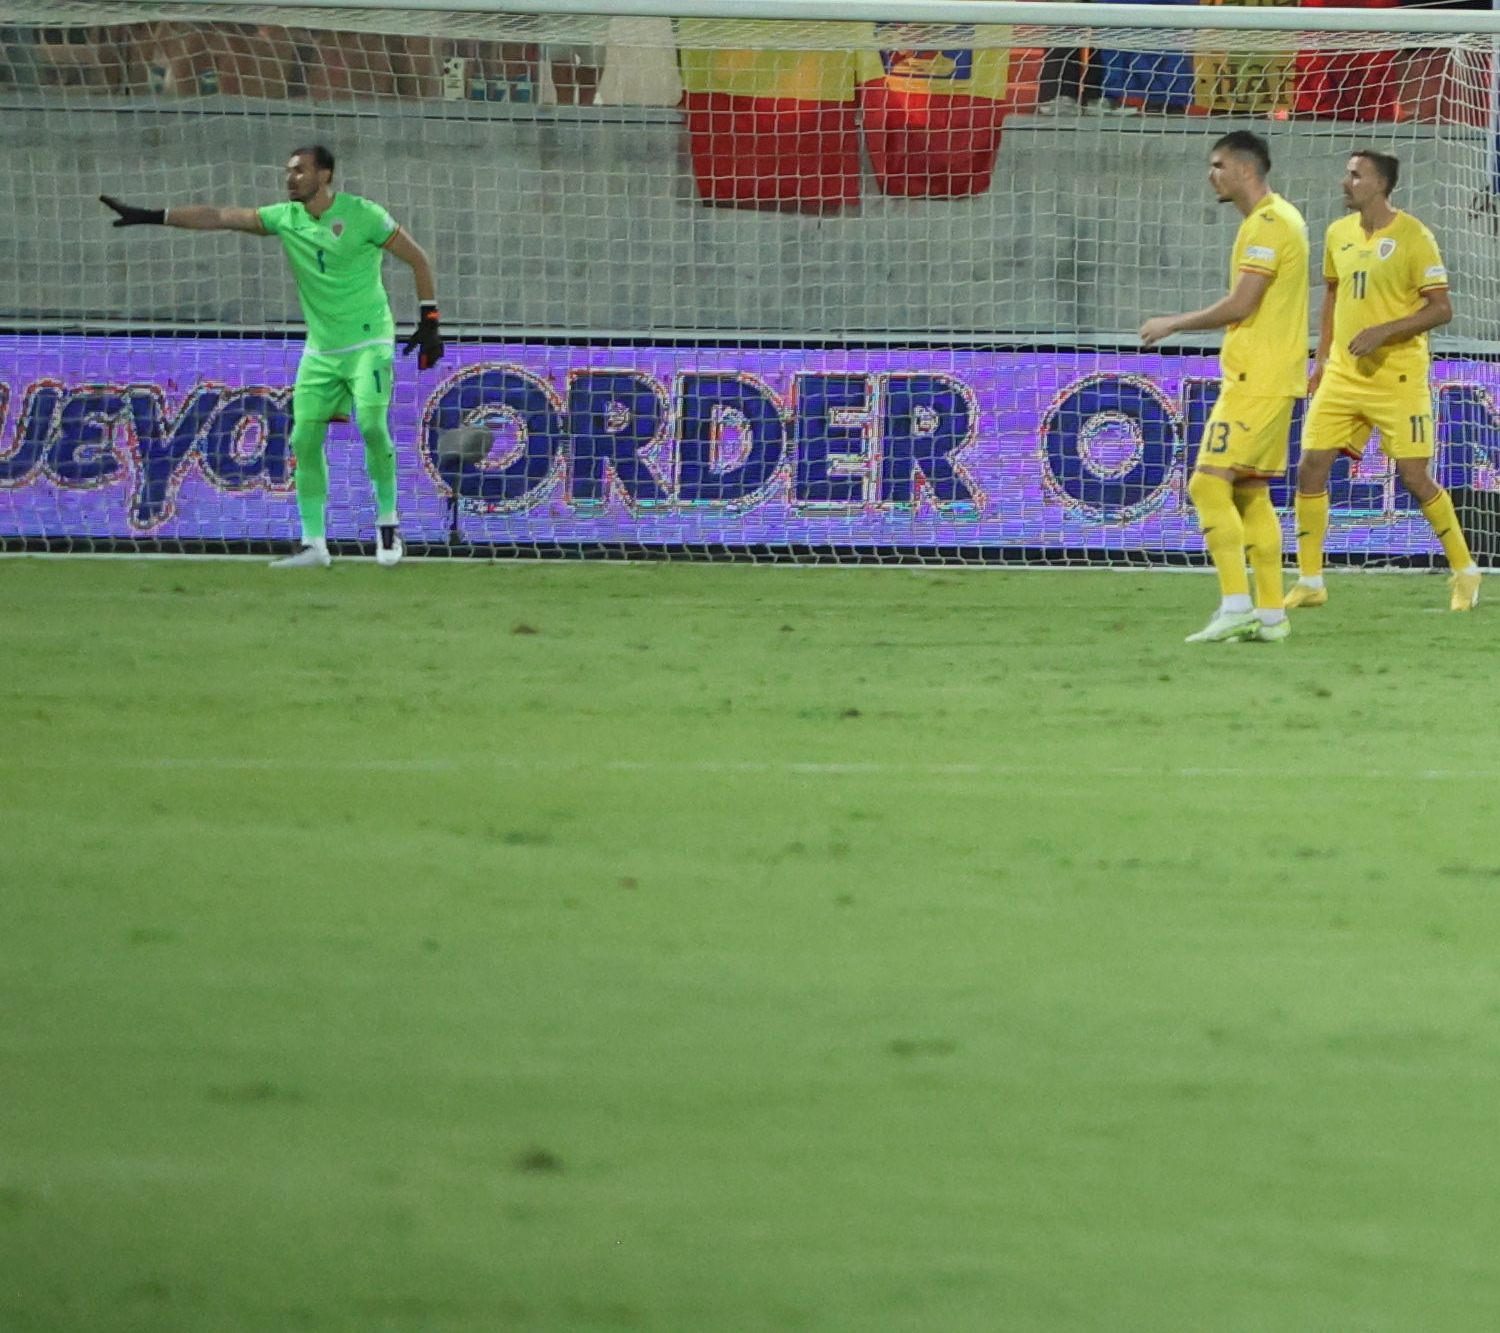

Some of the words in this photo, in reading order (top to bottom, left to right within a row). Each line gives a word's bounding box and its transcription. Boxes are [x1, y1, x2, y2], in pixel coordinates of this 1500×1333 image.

[1352, 270, 1368, 300] 11
[373, 369, 382, 394] 1
[1408, 414, 1426, 443] 11
[420, 362, 988, 525] ORDER
